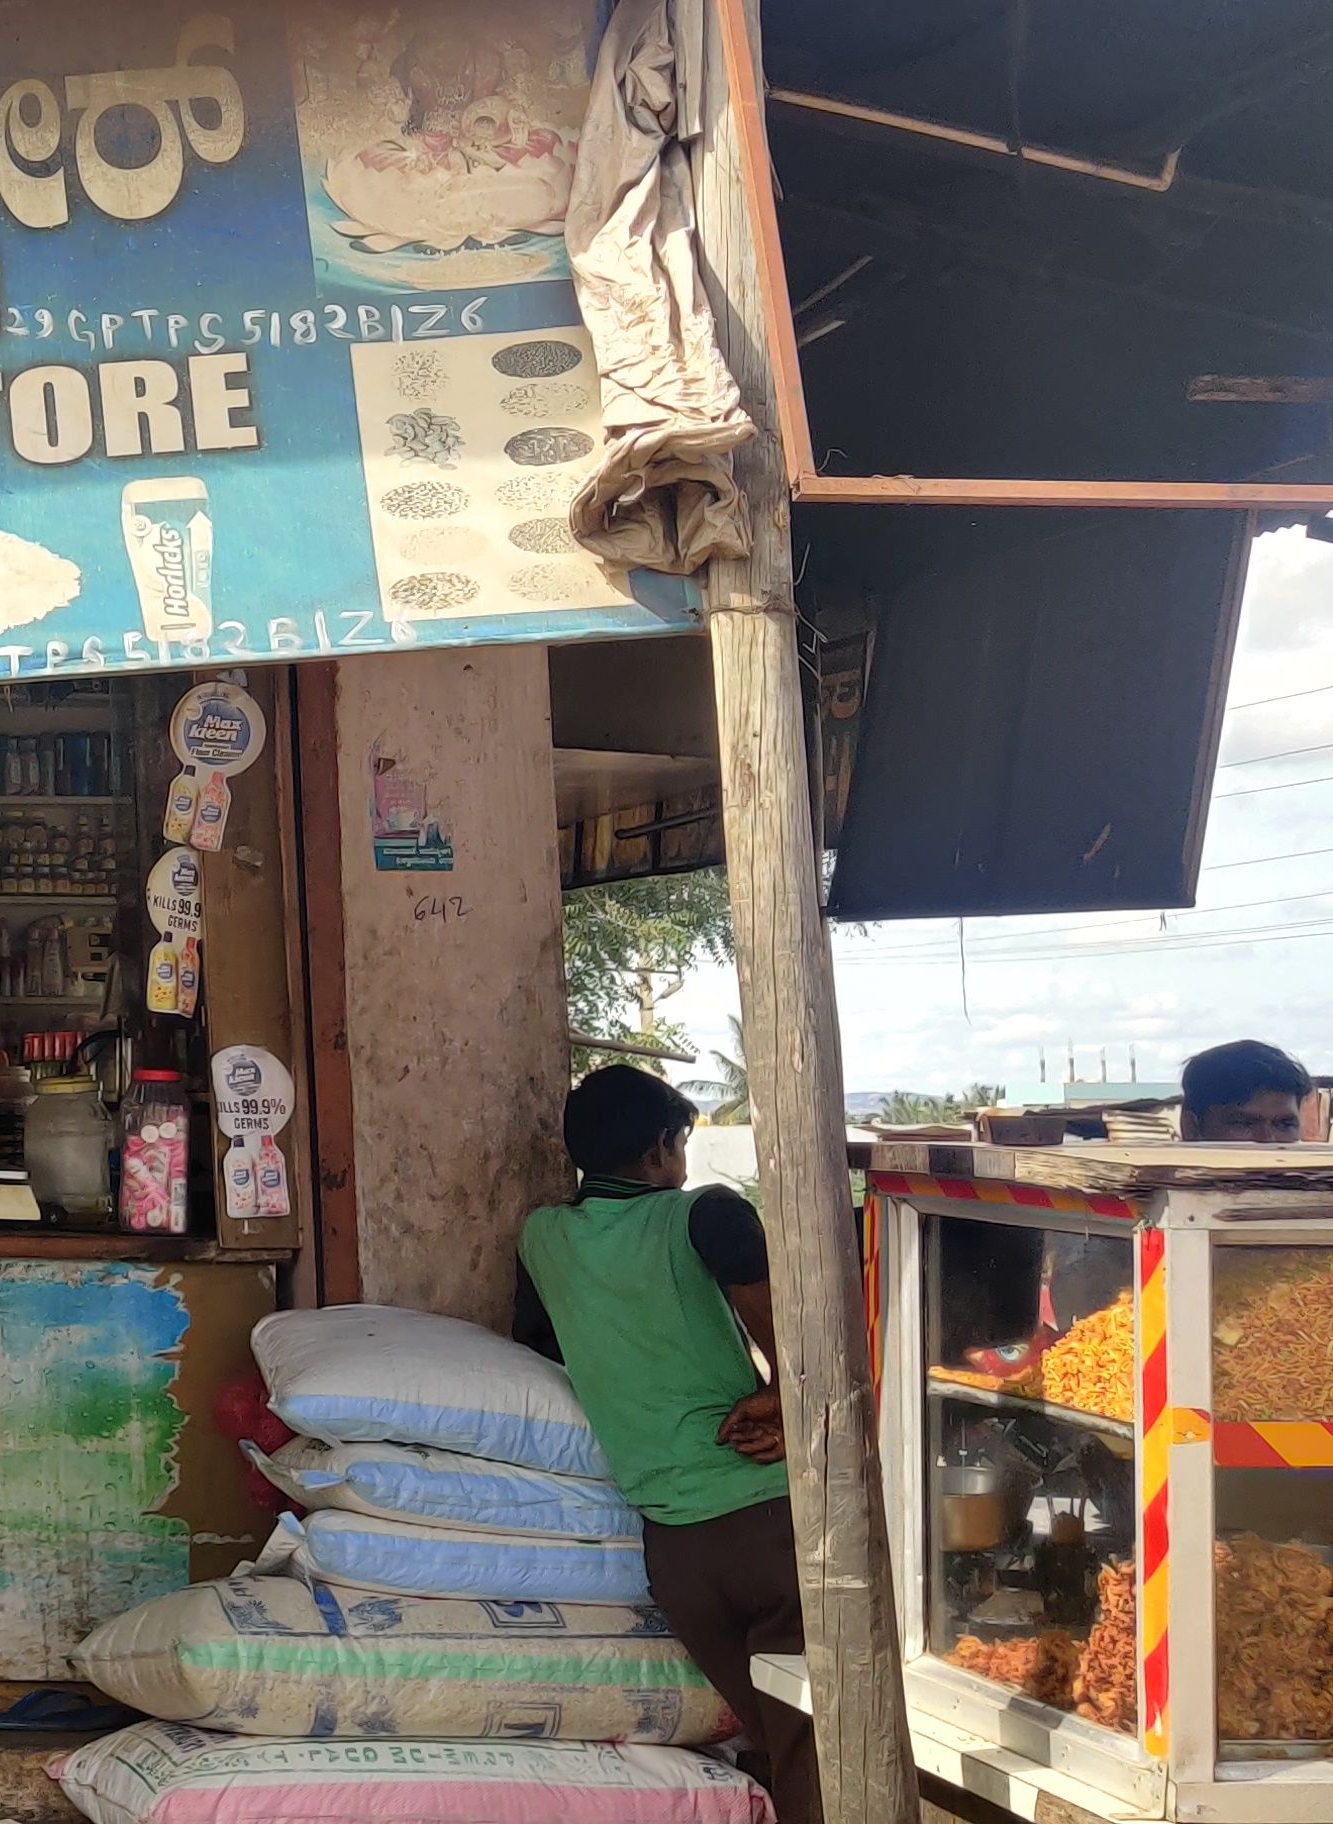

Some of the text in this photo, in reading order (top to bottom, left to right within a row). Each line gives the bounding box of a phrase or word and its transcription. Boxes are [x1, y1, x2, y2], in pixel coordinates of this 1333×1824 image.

[152, 526, 191, 617] Horlicks
[203, 714, 244, 732] Max
[152, 895, 177, 912] KILLS
[413, 894, 472, 923] 642
[167, 914, 199, 932] GERMS
[217, 1098, 287, 1116] ILLS 99.9%
[234, 1117, 270, 1130] GERMS
